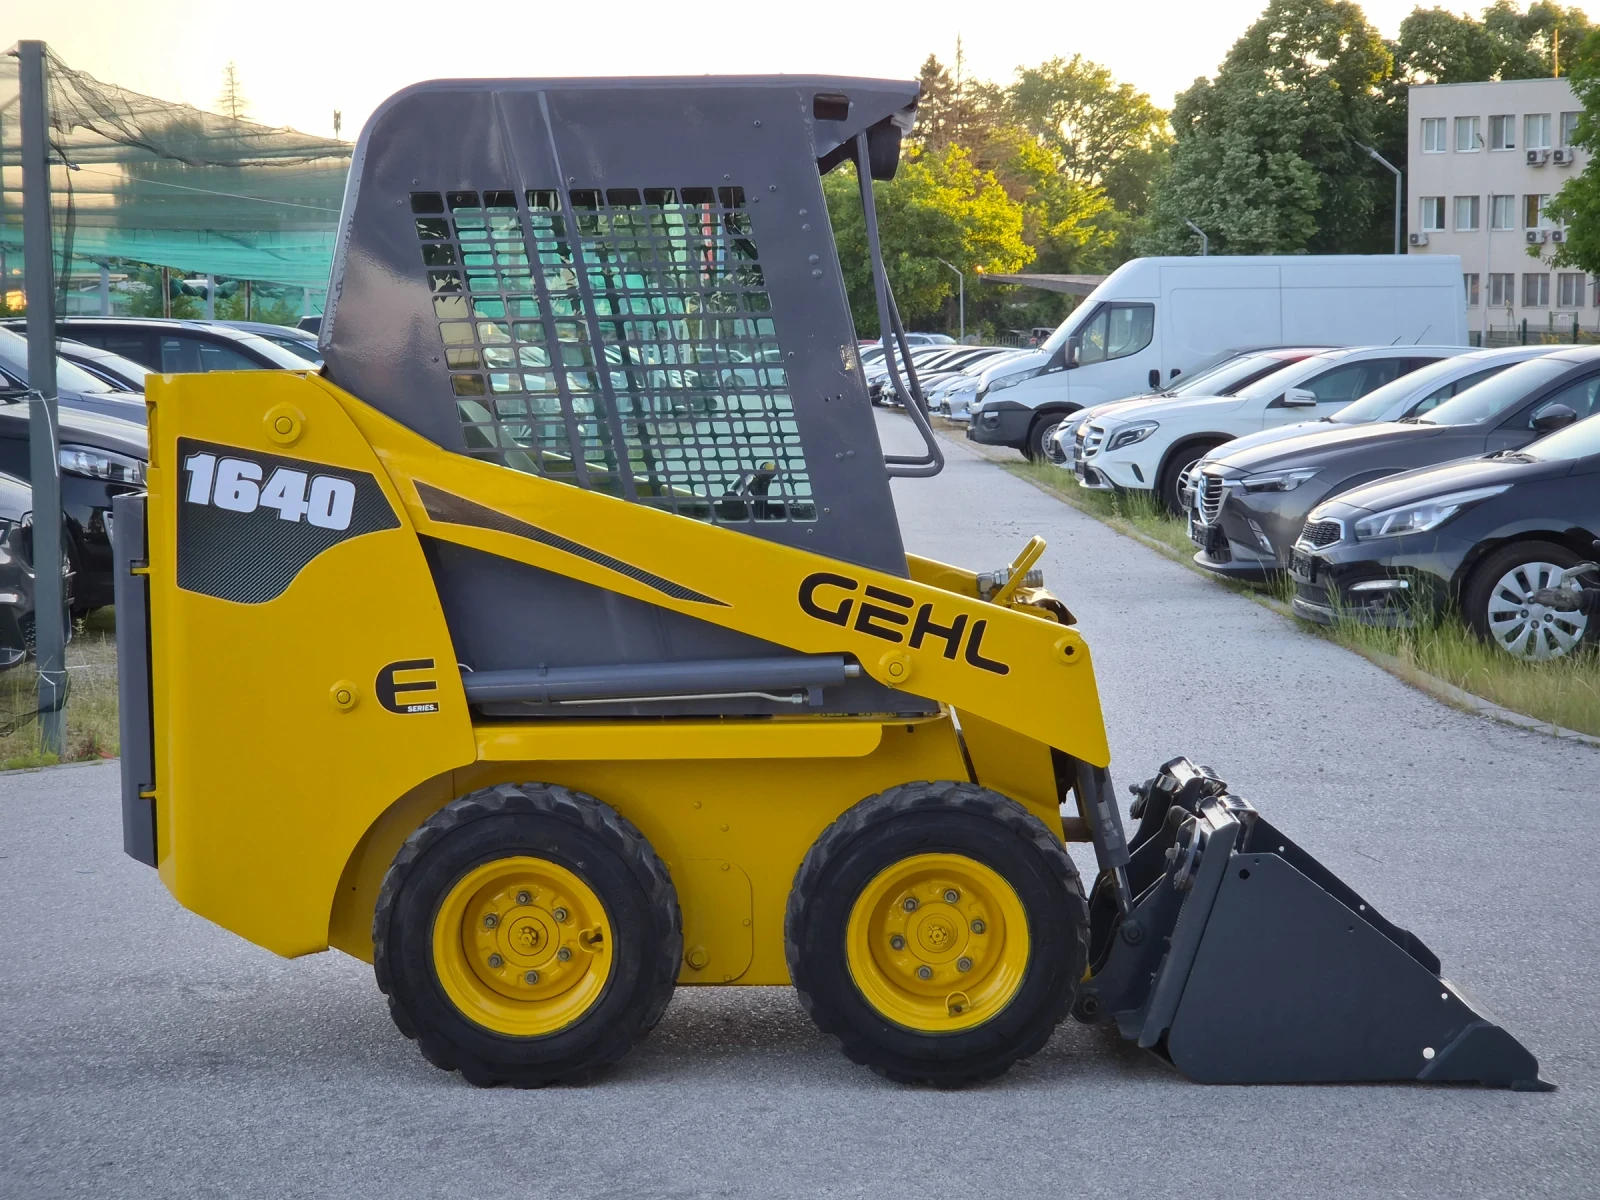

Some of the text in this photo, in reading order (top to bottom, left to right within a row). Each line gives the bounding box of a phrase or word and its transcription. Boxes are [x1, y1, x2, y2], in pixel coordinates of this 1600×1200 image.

[184, 451, 356, 531] 1640
[798, 572, 1010, 675] GEHL
[375, 658, 439, 714] E
